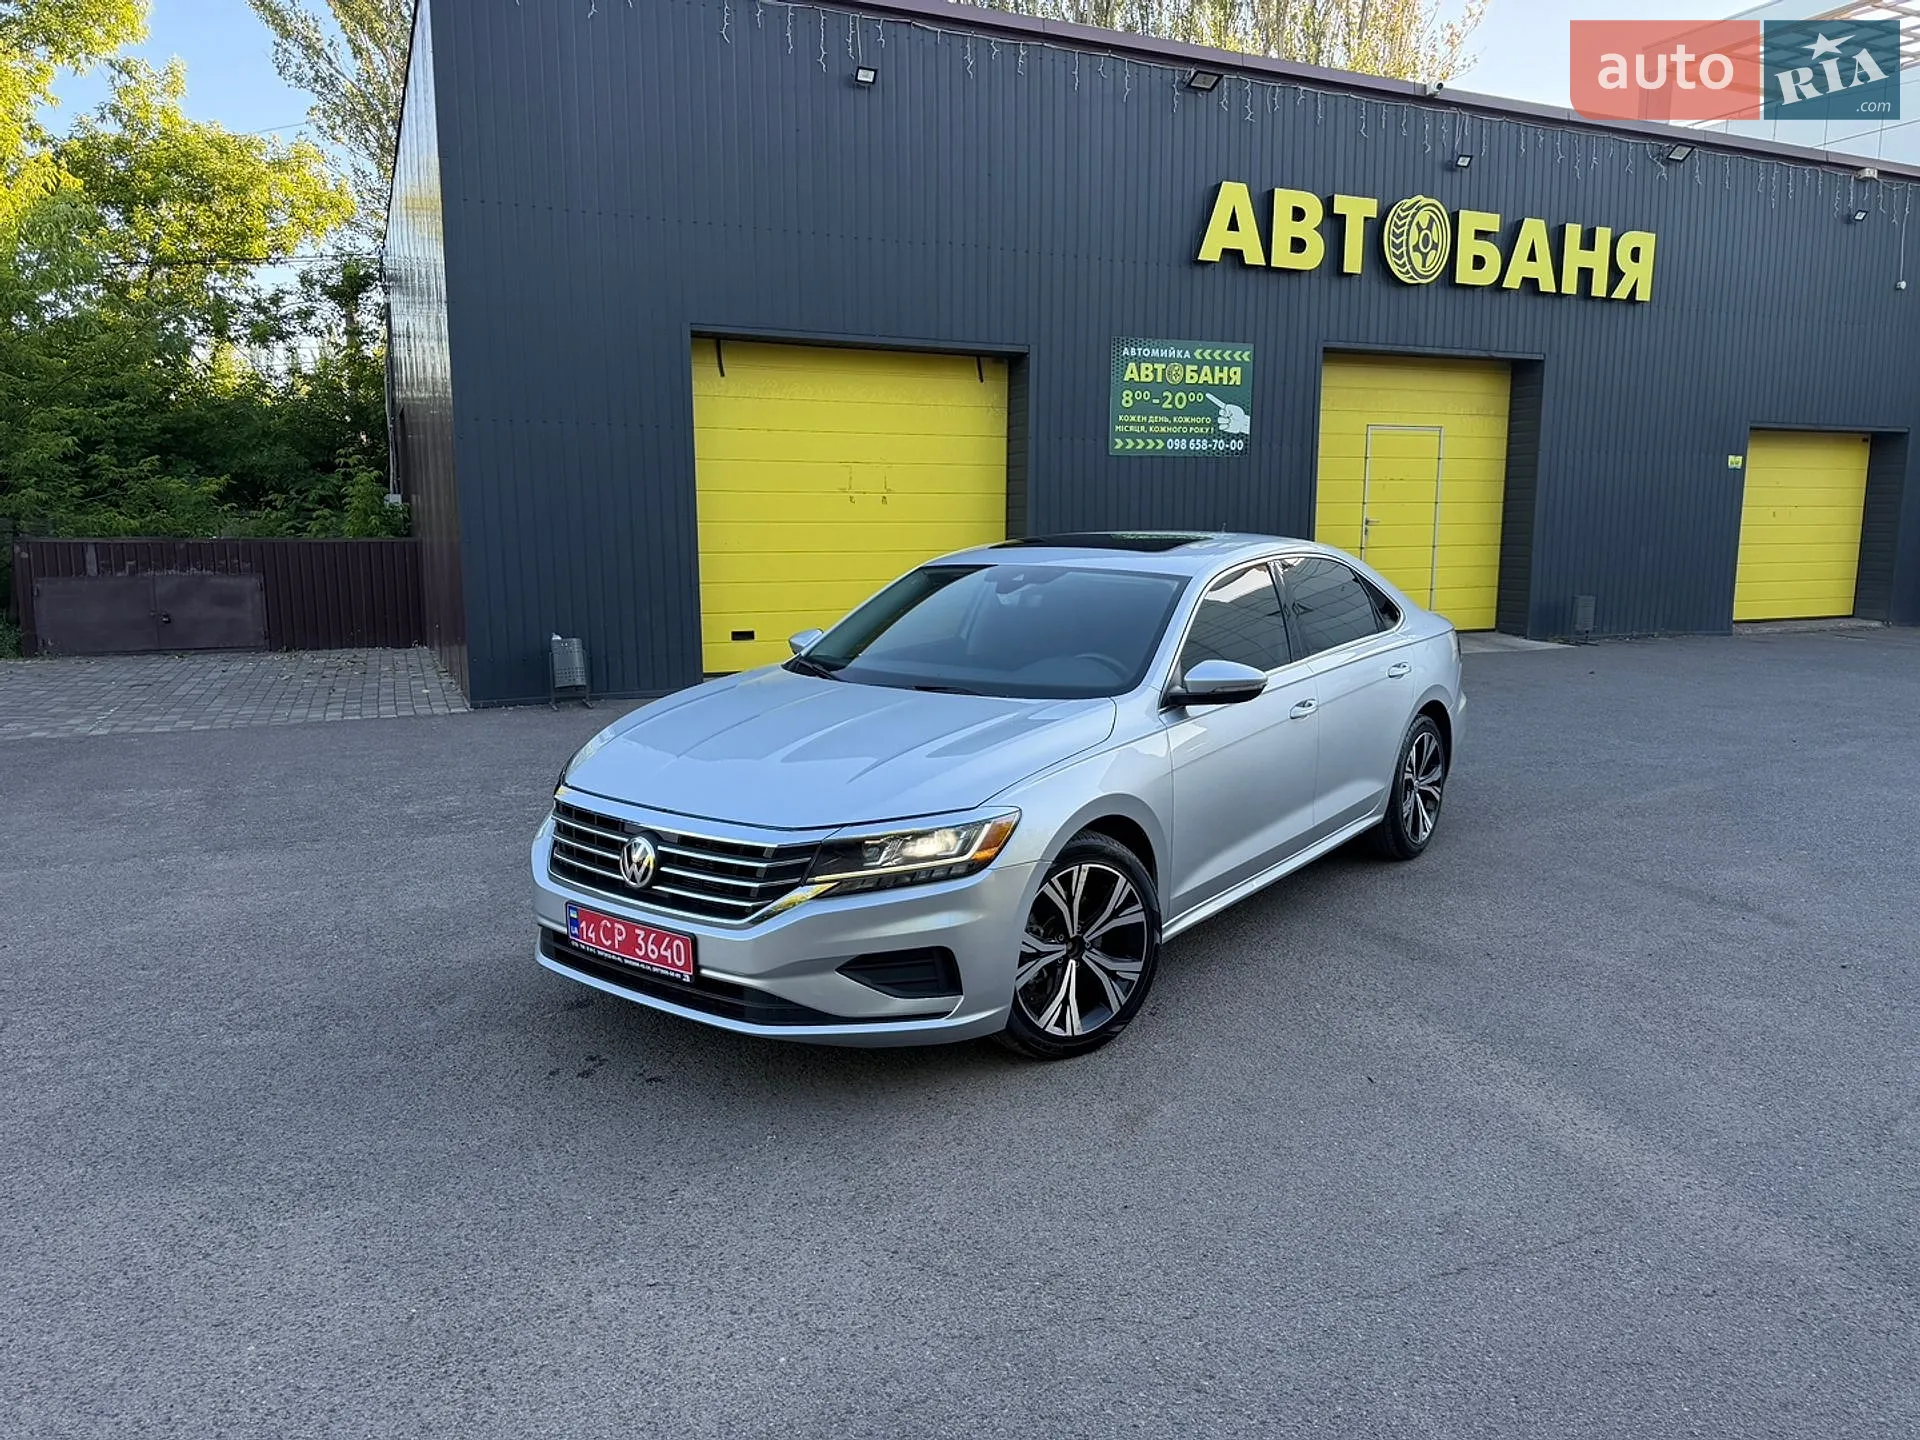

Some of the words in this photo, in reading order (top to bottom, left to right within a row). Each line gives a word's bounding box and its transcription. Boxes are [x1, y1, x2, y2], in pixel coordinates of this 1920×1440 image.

[1197, 180, 1656, 302] АВТОБАНЯ
[1122, 346, 1191, 359] АВТОМИЙКА
[1123, 361, 1242, 386] АВТОБАНЯ
[1118, 414, 1147, 424] КОЖЕН
[1148, 415, 1172, 424] ДЕНЬ,
[1173, 416, 1212, 424] КОЖНОГО
[1149, 425, 1188, 434] КОЖНОГО
[1166, 438, 1187, 450] 098
[1189, 439, 1244, 451] 658-70-00
[635, 929, 685, 967] 3640
